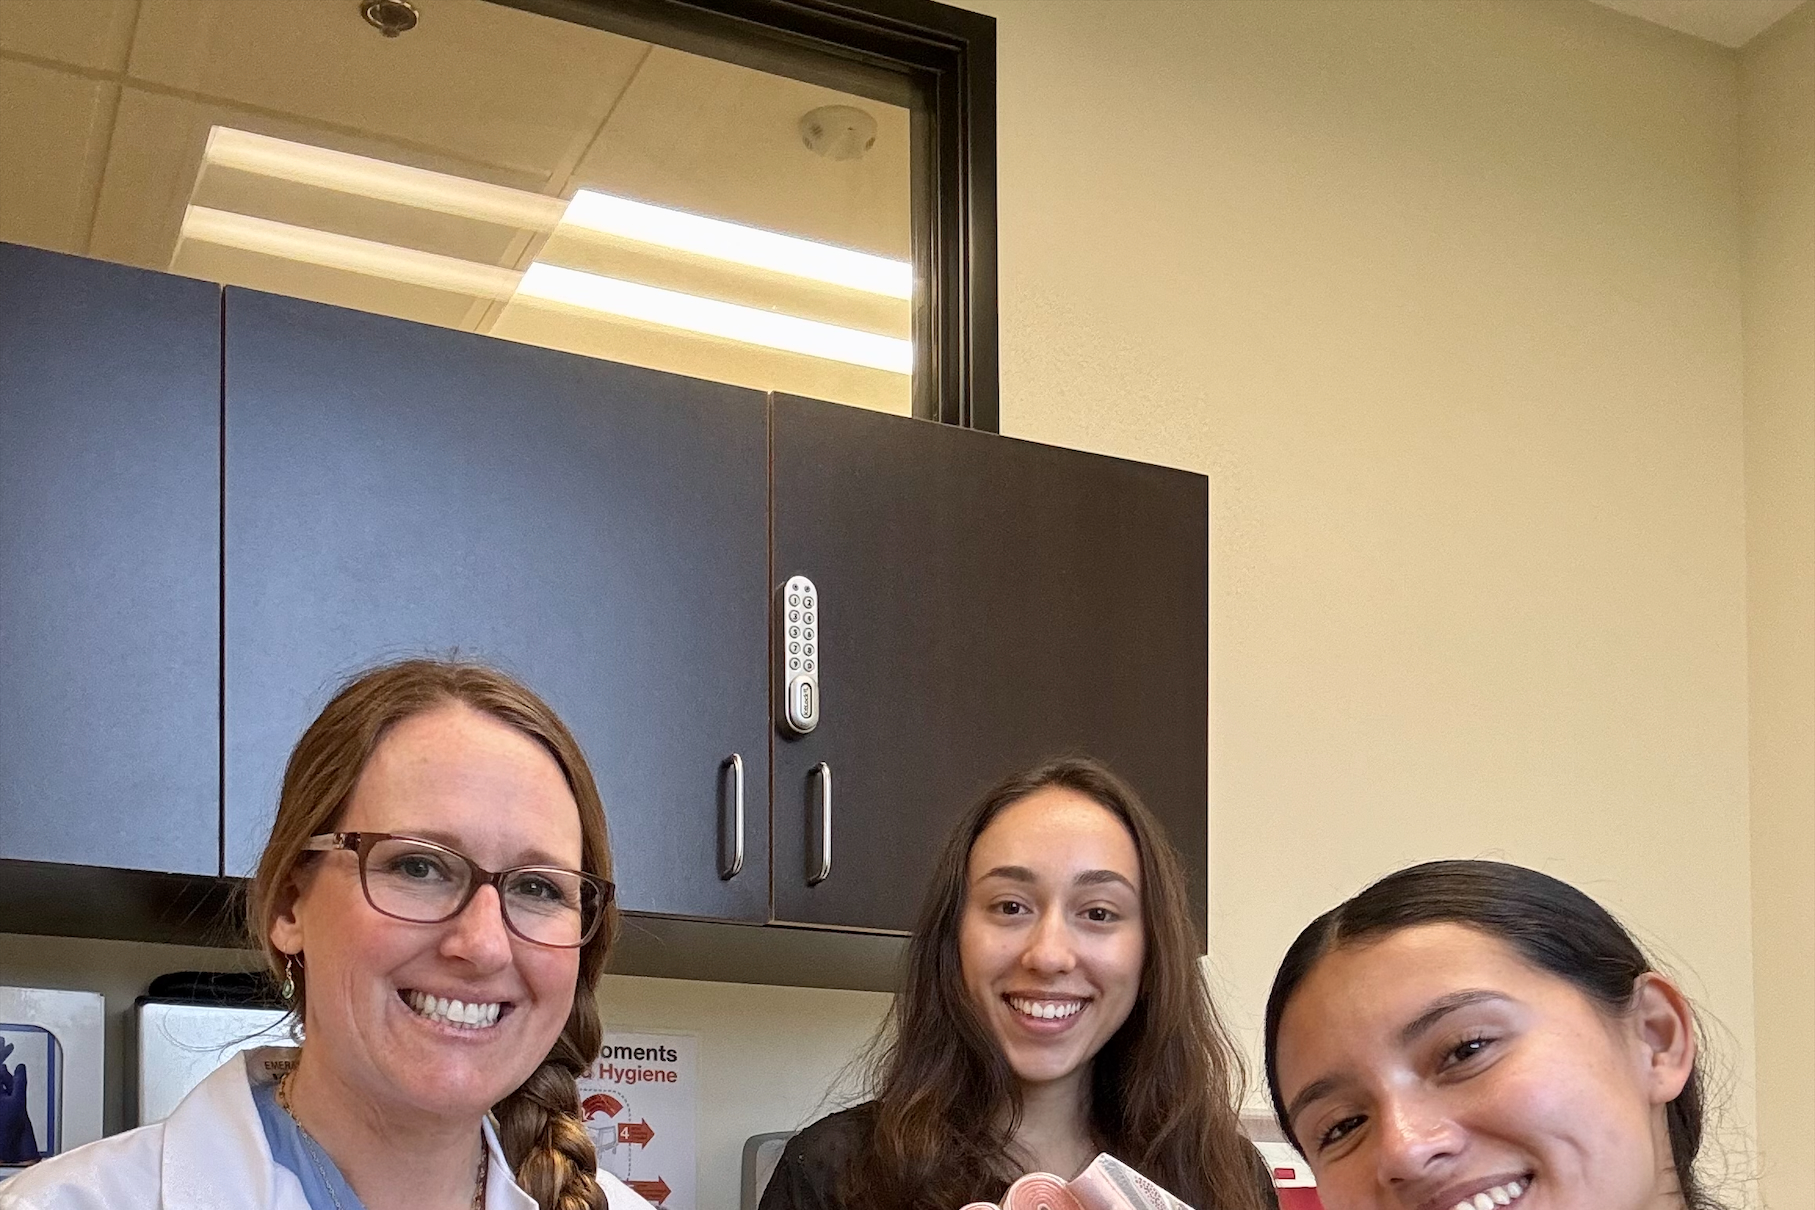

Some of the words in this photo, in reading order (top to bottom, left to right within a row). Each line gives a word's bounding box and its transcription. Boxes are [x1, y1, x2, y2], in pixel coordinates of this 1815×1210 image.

[601, 1045, 678, 1062] oments
[599, 1063, 678, 1085] Hygiene
[620, 1126, 630, 1140] 4
